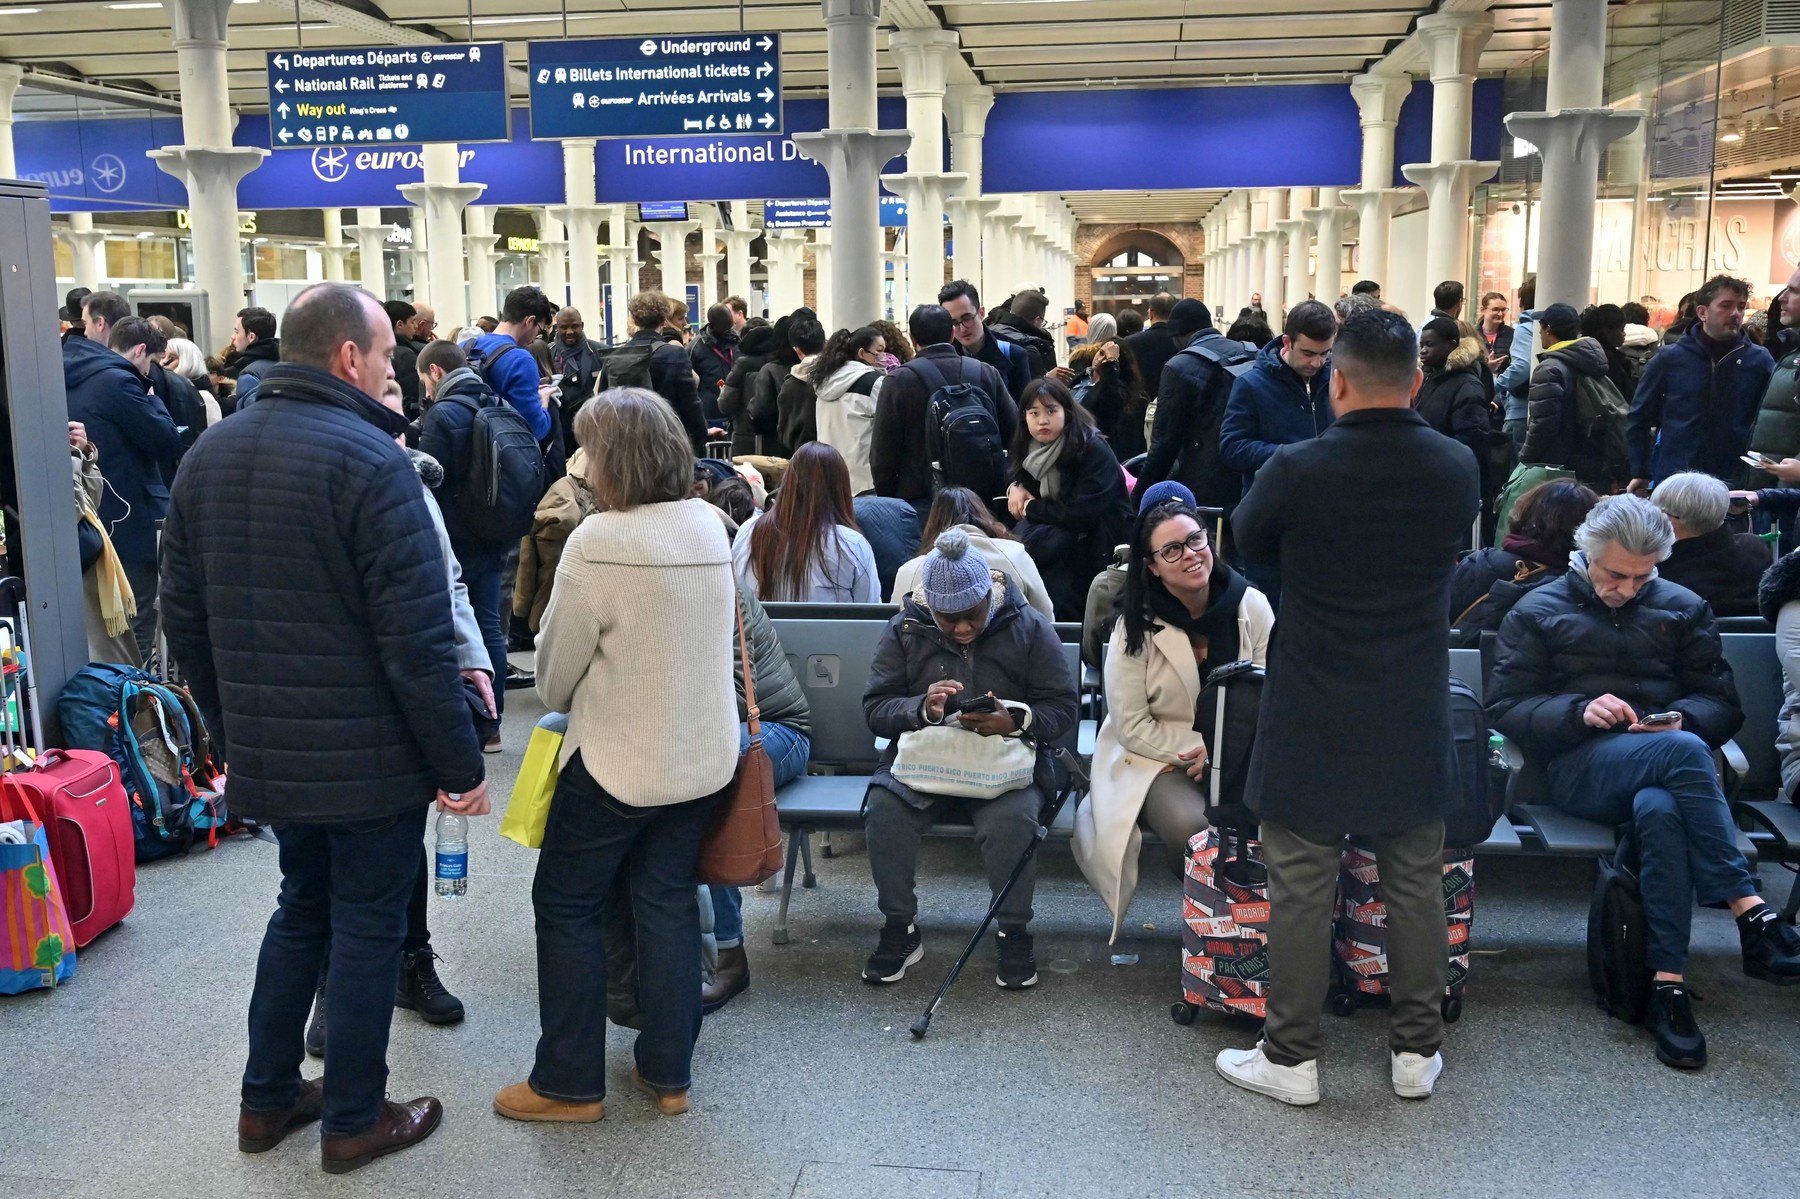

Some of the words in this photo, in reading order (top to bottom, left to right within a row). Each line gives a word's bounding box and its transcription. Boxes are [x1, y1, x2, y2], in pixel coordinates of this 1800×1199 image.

[662, 38, 750, 55] Underground
[293, 53, 364, 69] Departures
[367, 50, 418, 67] Départs
[433, 53, 465, 61] eurostar
[570, 68, 612, 81] Billets
[616, 65, 702, 81] International
[705, 64, 750, 77] tickets
[294, 78, 347, 92] National
[350, 76, 375, 90] Rail
[378, 81, 409, 90] platforms
[601, 97, 633, 105] eurostar
[637, 90, 694, 105] Arrivées
[697, 88, 751, 103] Arrivals
[296, 104, 324, 119] Way
[326, 102, 346, 115] out
[350, 107, 369, 116] King's
[355, 150, 475, 170] eurosr
[625, 140, 774, 165] International
[775, 200, 807, 208] Departures
[390, 258, 396, 276] 3
[509, 263, 515, 279] 2
[902, 763, 917, 771] RICO
[918, 764, 945, 774] PUERTO
[945, 767, 962, 776] RICO
[963, 770, 991, 781] PUERTO
[991, 773, 1008, 781] RICO
[1189, 921, 1214, 936] ONDON
[1351, 959, 1383, 976] ONDON
